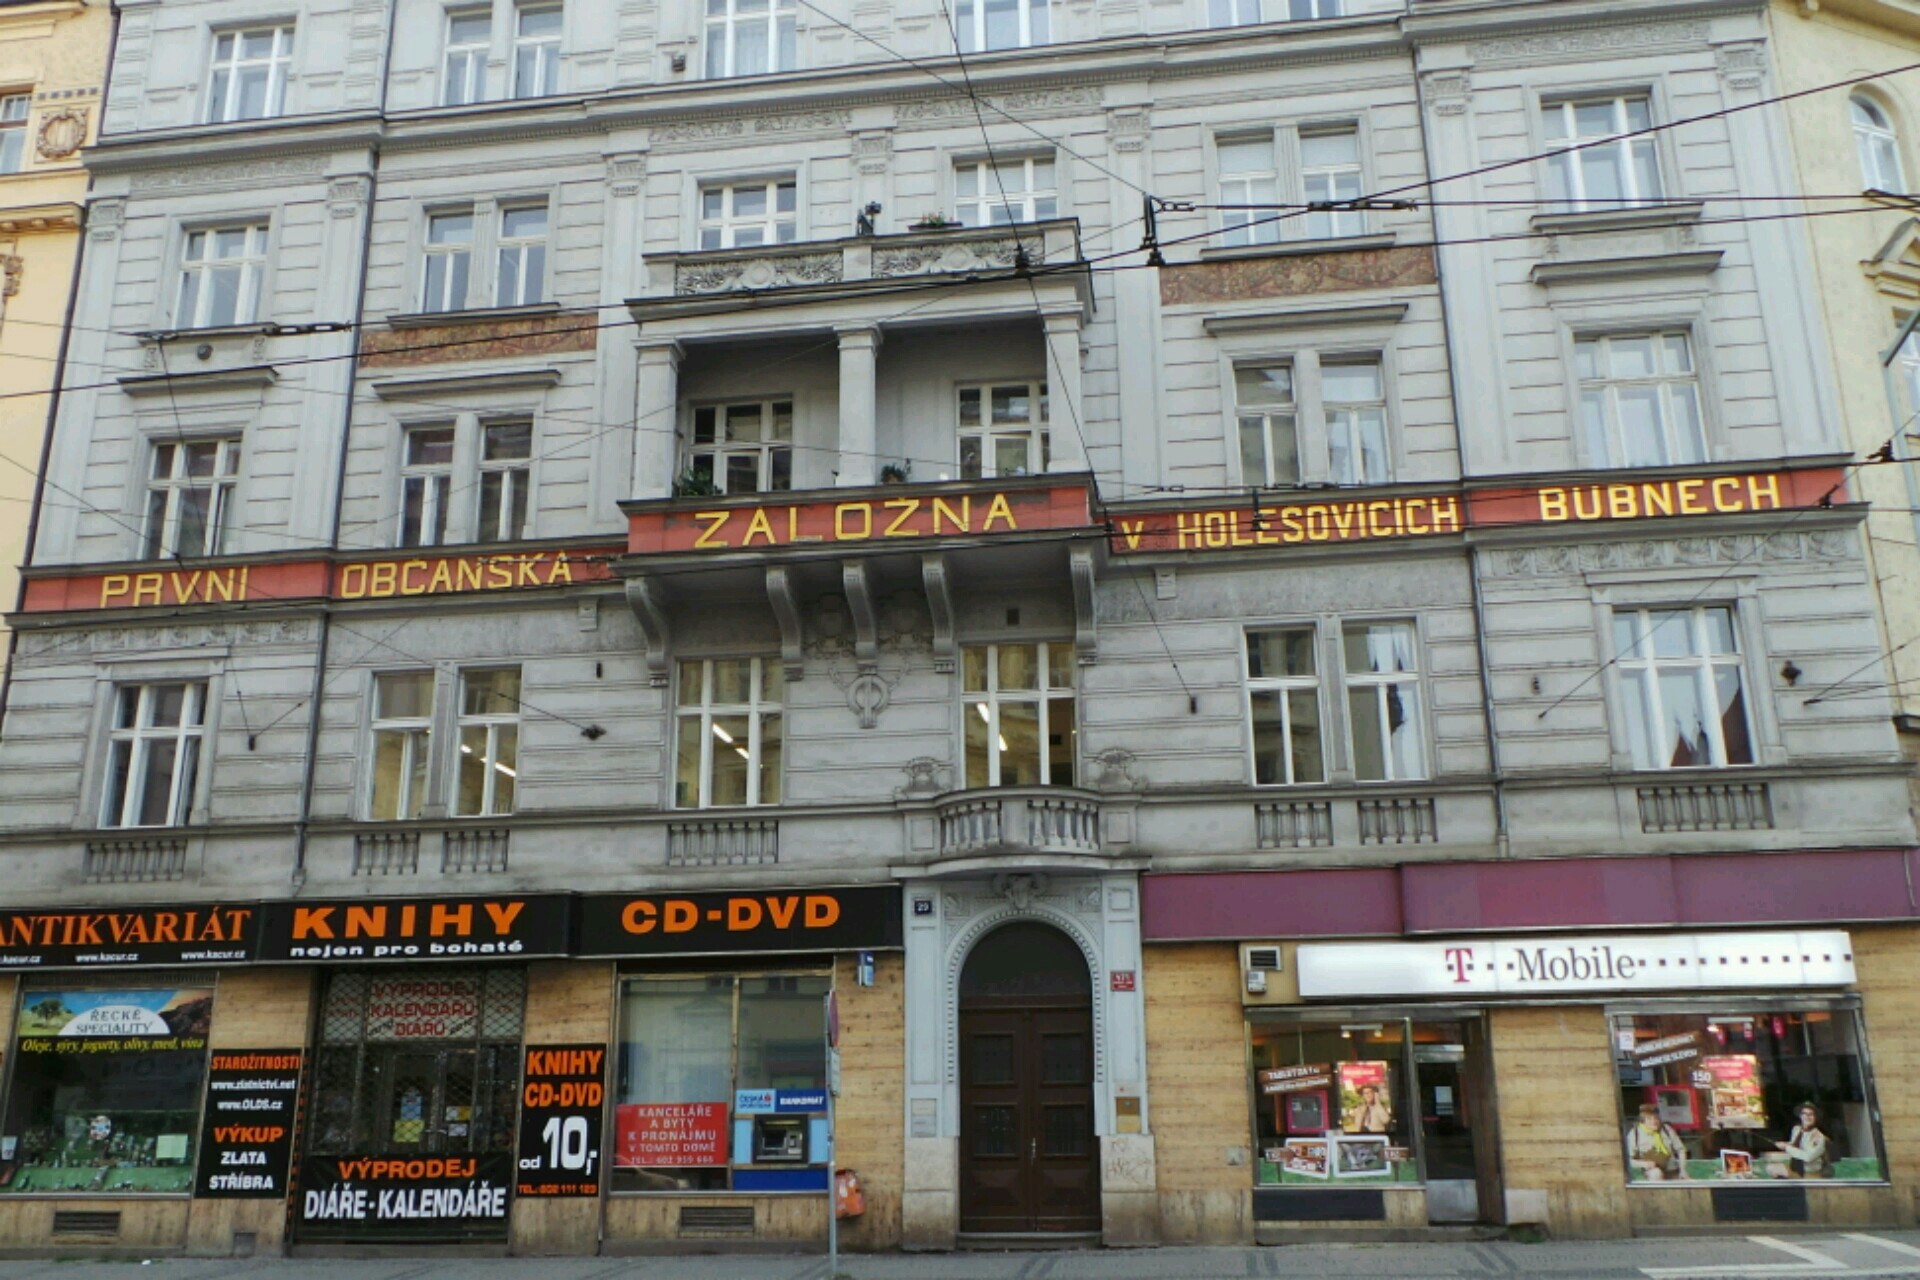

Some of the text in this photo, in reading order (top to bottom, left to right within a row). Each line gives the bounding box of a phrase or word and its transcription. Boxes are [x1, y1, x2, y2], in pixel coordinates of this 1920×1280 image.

[292, 902, 526, 939] KNIHY
[621, 895, 841, 934] CD-DVD
[290, 940, 524, 959] nejen pro bohaté
[0, 954, 41, 965] .kacur.cz
[1513, 946, 1636, 982] Mobile
[527, 1050, 603, 1075] KNIHY
[525, 1082, 602, 1107] CD-DVD
[638, 1104, 713, 1117] KANCELÁŘE
[213, 1122, 285, 1143] VÝKUP
[649, 1118, 695, 1129] A BYTY
[641, 1128, 717, 1141] PRONÁJMU
[640, 1142, 679, 1153] TOMTO
[220, 1151, 267, 1165] ZLATA
[519, 1155, 542, 1170] od
[337, 1157, 478, 1180] VÝPRODEJ
[208, 1171, 274, 1190] STŘÍBRA
